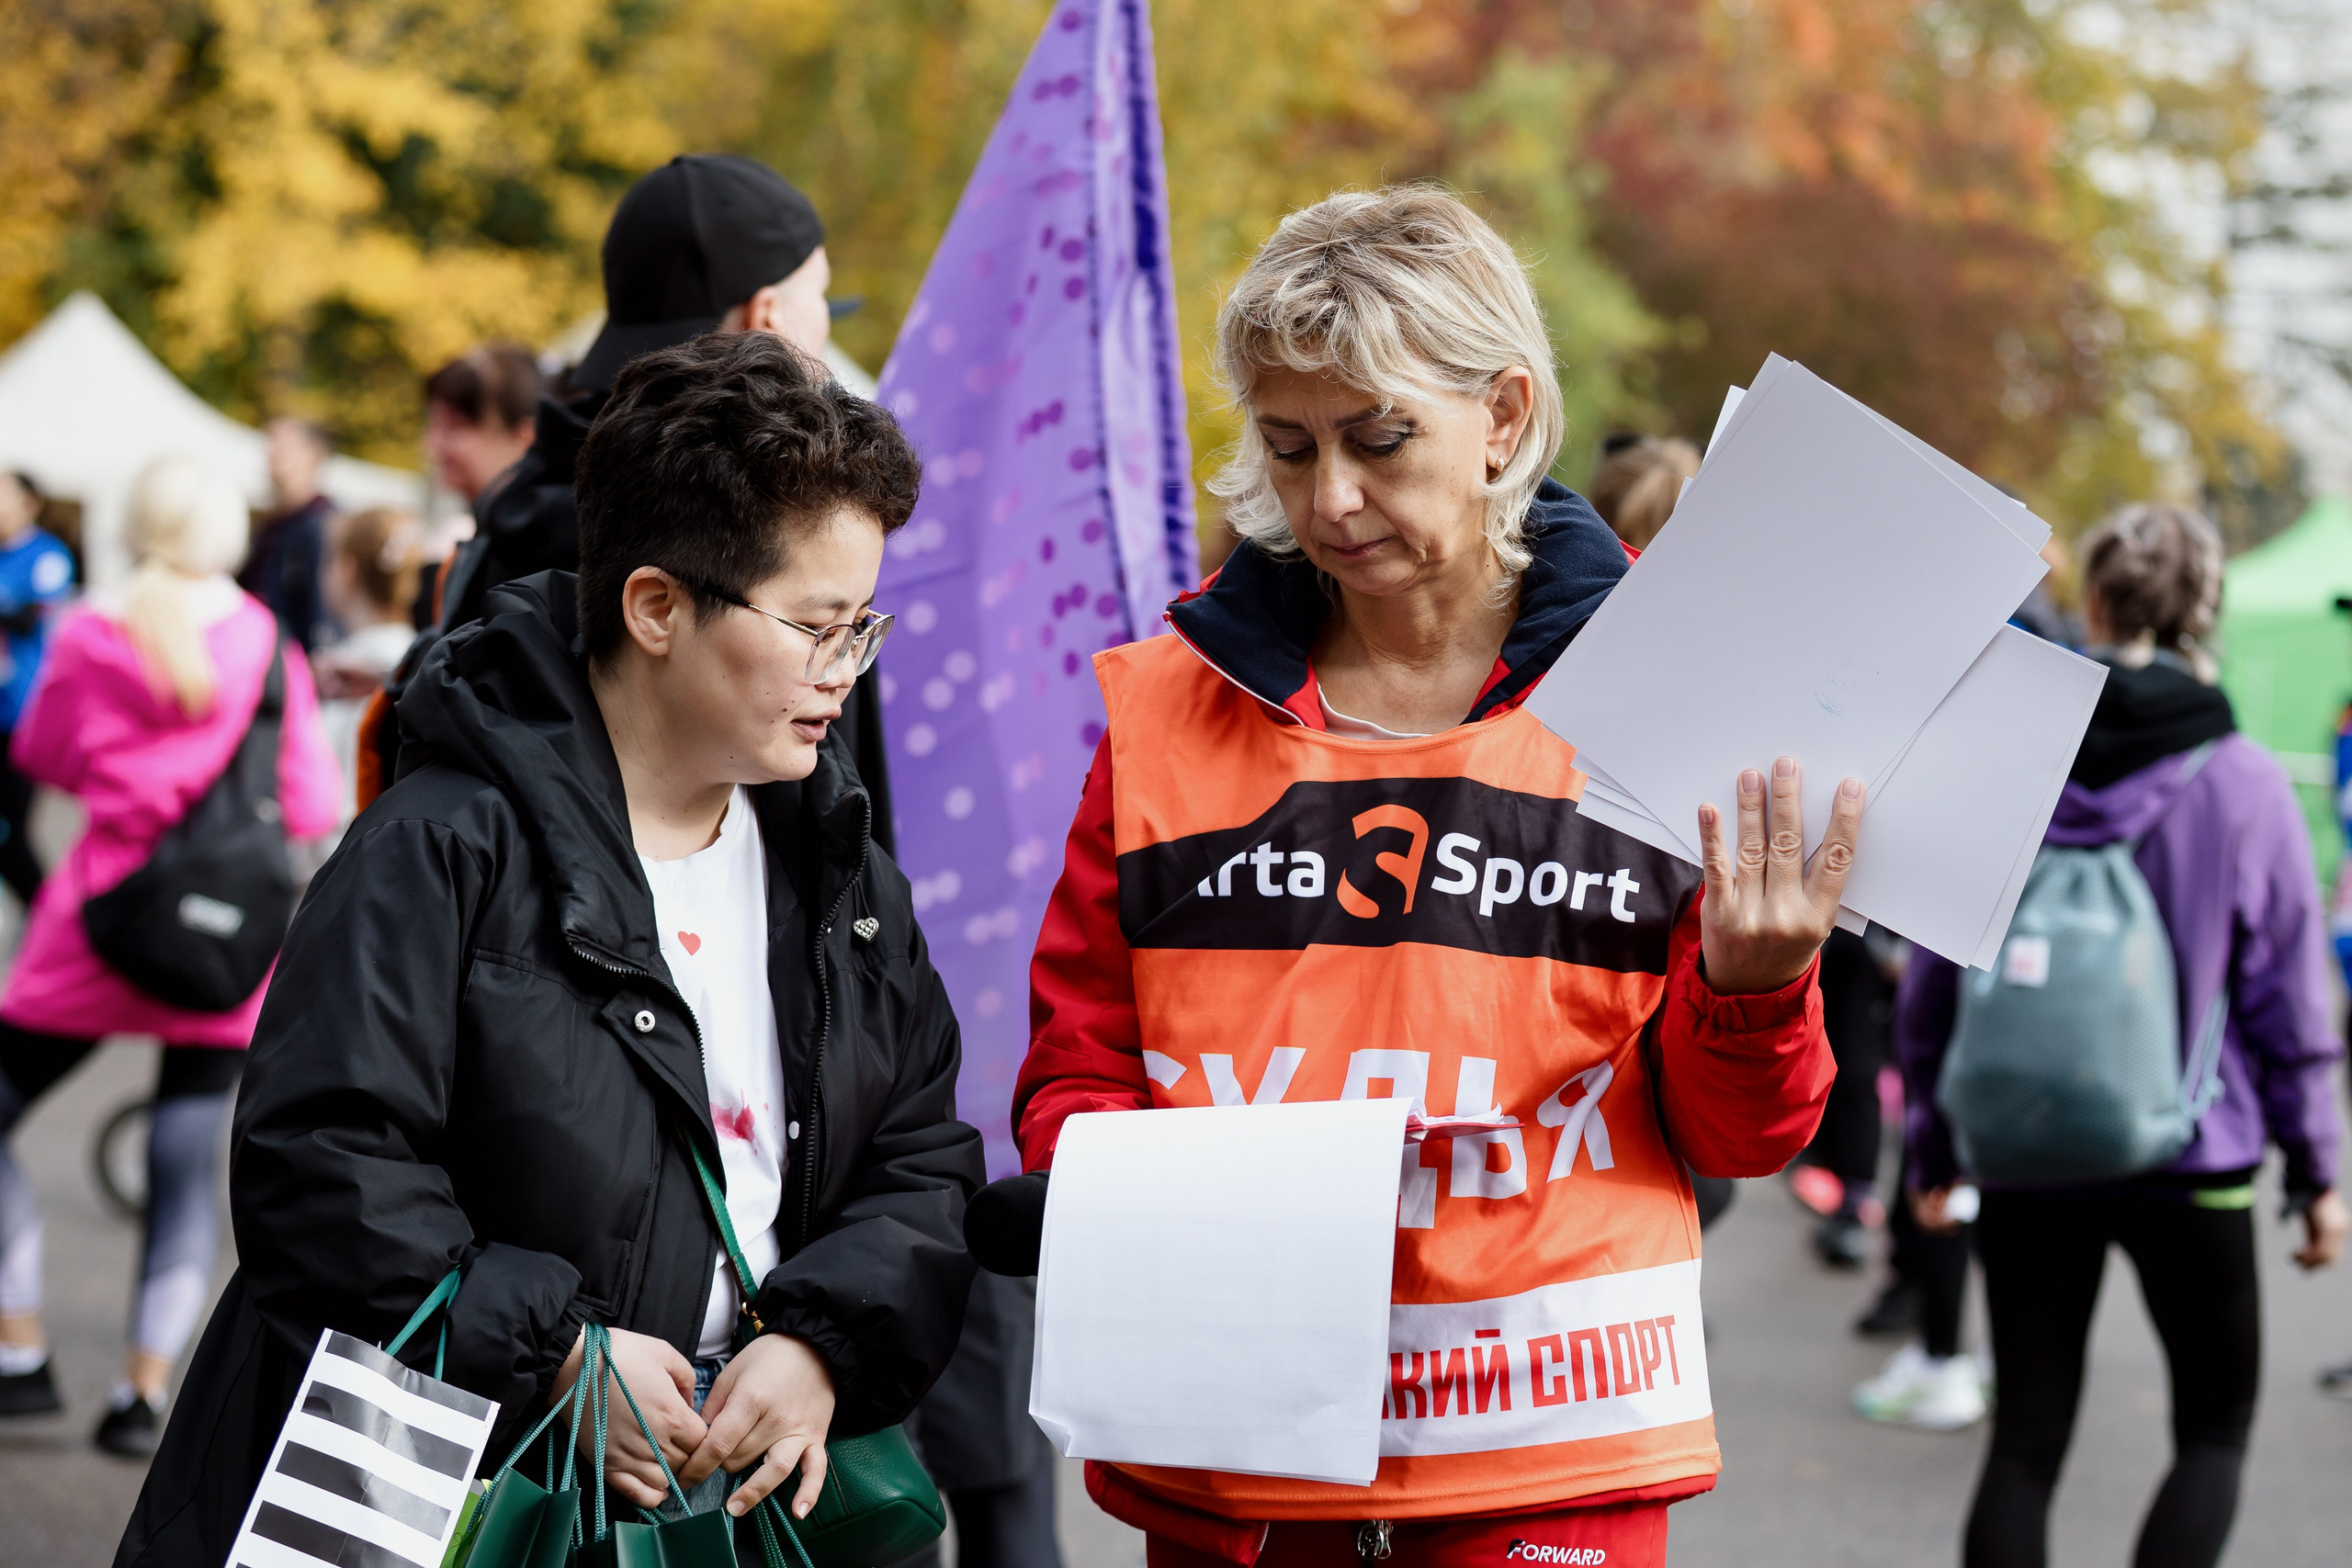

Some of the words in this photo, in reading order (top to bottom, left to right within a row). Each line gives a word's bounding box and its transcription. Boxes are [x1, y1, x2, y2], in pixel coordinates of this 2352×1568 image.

[1197, 841, 1326, 897] rta
[1430, 832, 1640, 923] Sport
[1382, 1328, 1511, 1419] КИЙ
[1527, 1314, 1679, 1407] СПОРТ
[1506, 1539, 1606, 1566] FORWARD
